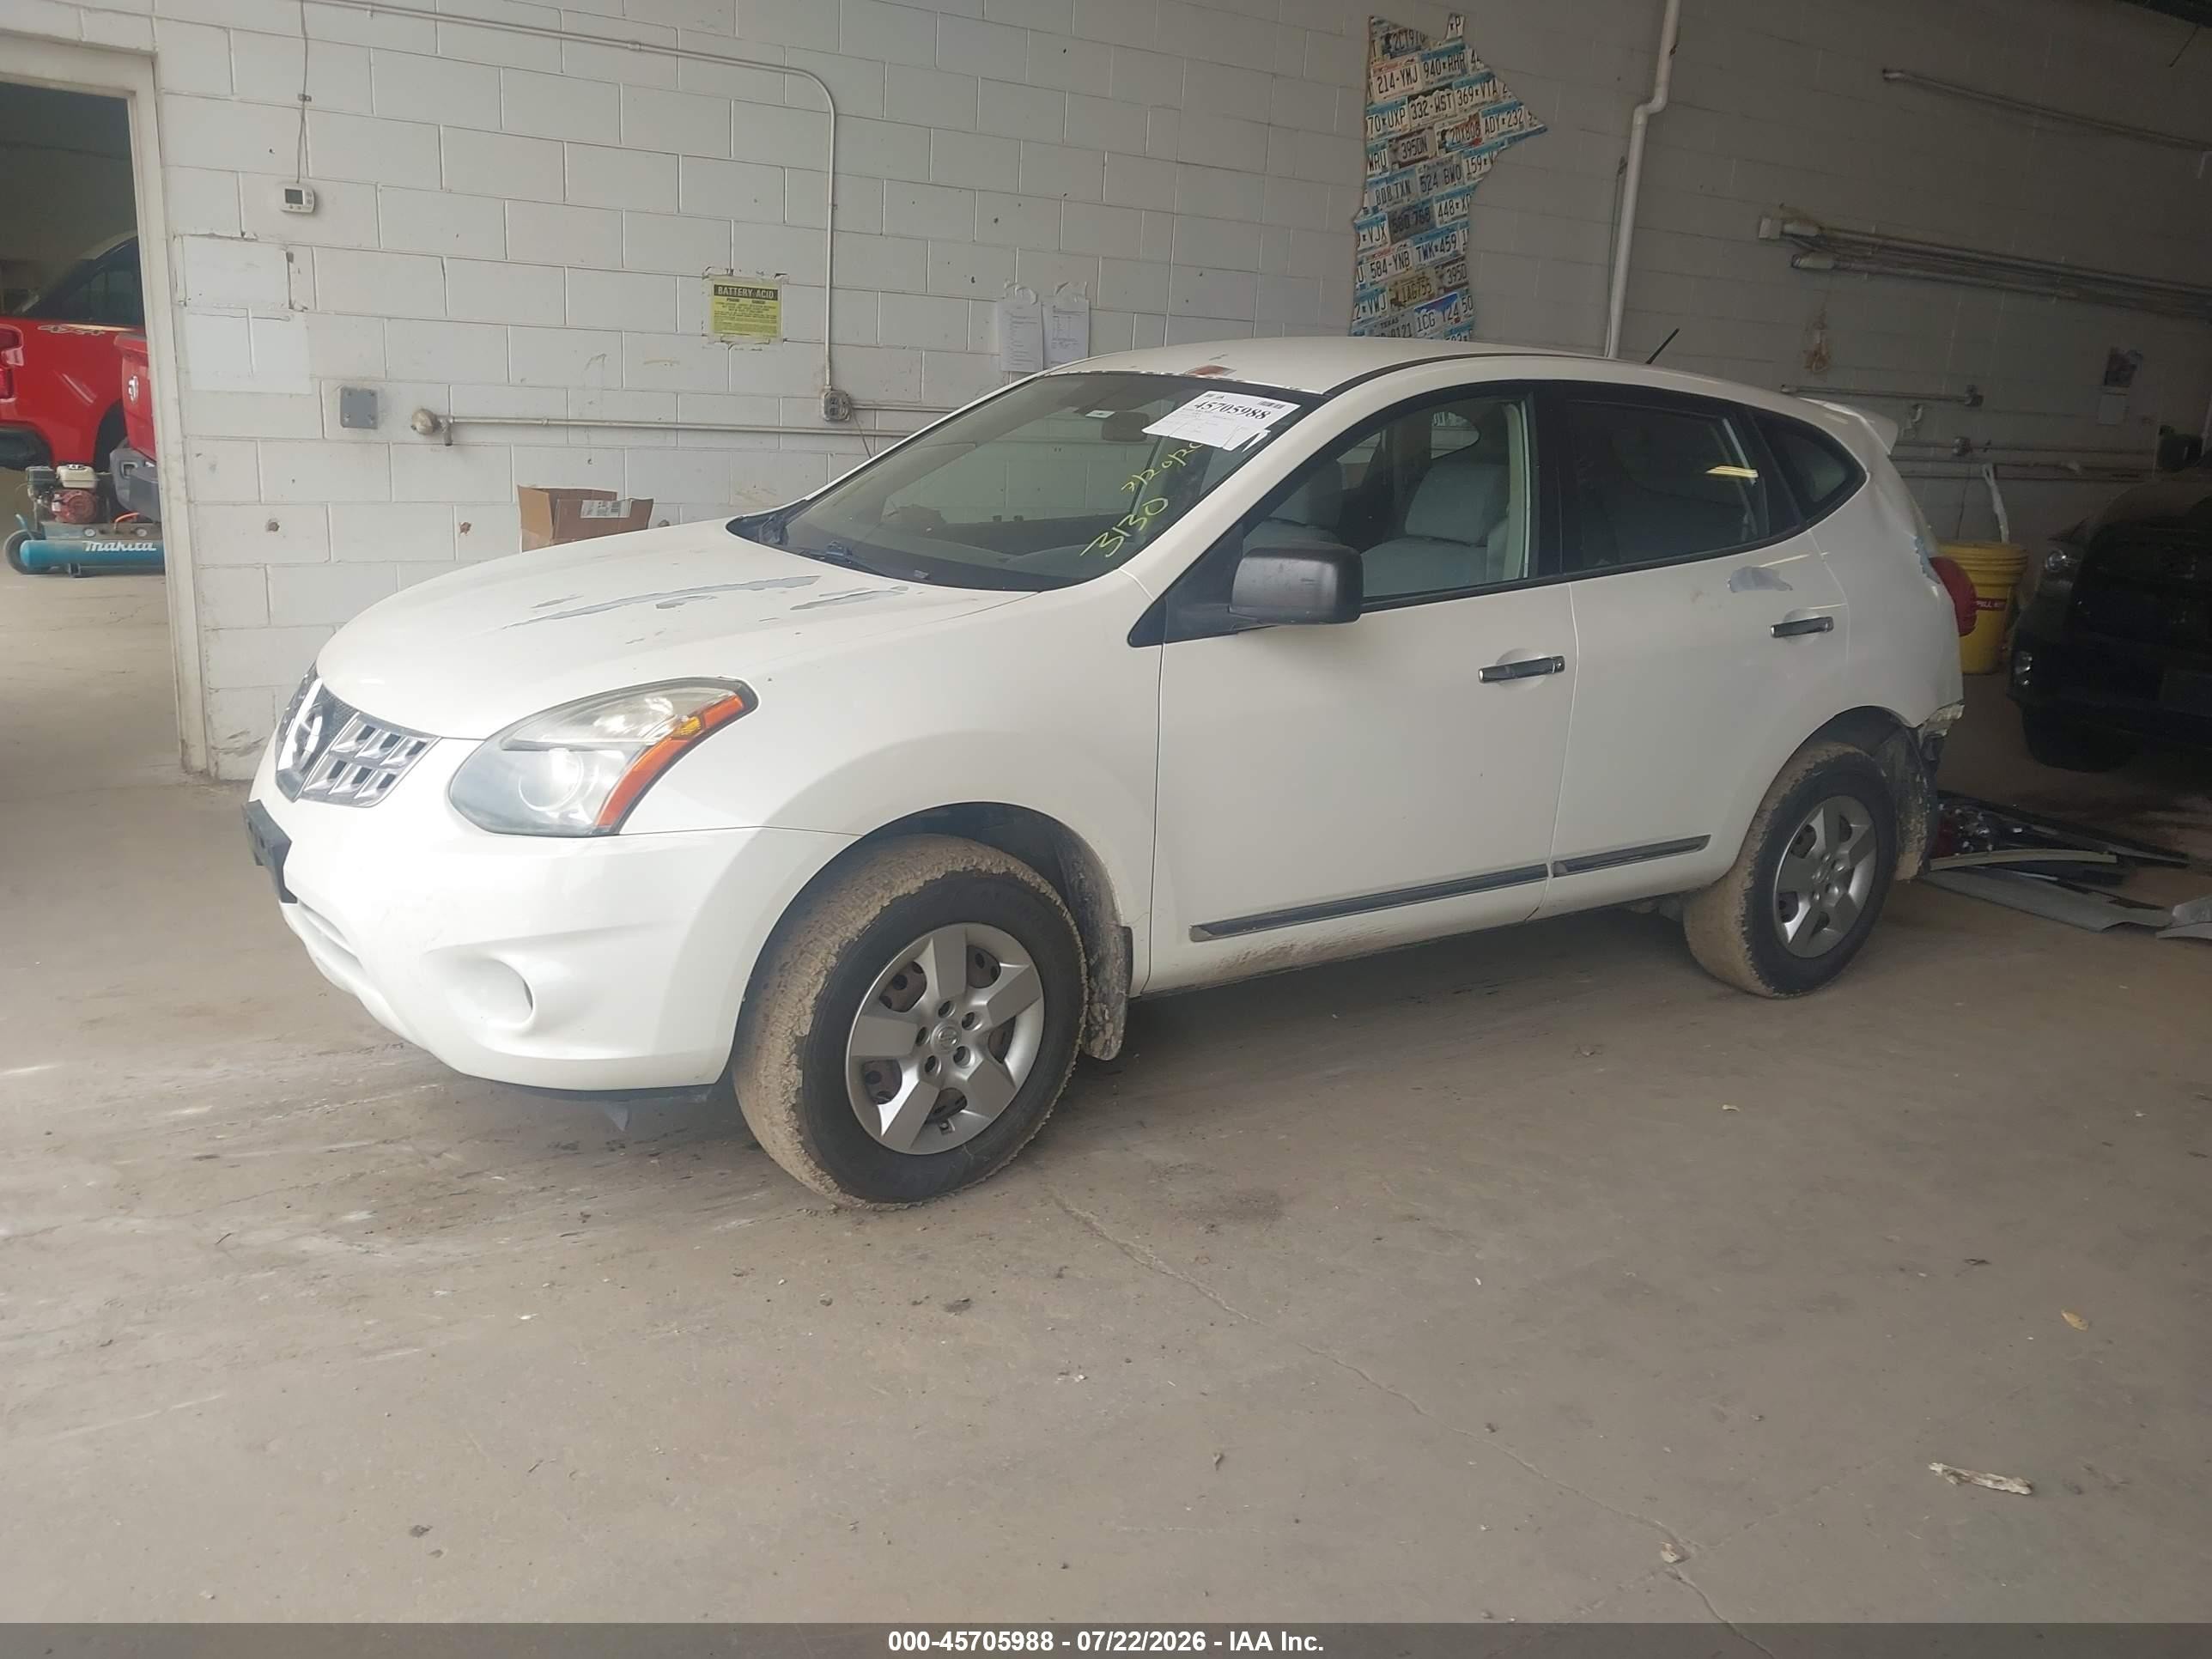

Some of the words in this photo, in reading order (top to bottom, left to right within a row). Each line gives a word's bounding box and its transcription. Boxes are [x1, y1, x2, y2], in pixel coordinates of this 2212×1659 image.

[718, 286, 753, 297] BATTERY
[756, 289, 774, 299] ACID
[1194, 401, 1271, 419] 45705988
[1080, 497, 1169, 557] 3130
